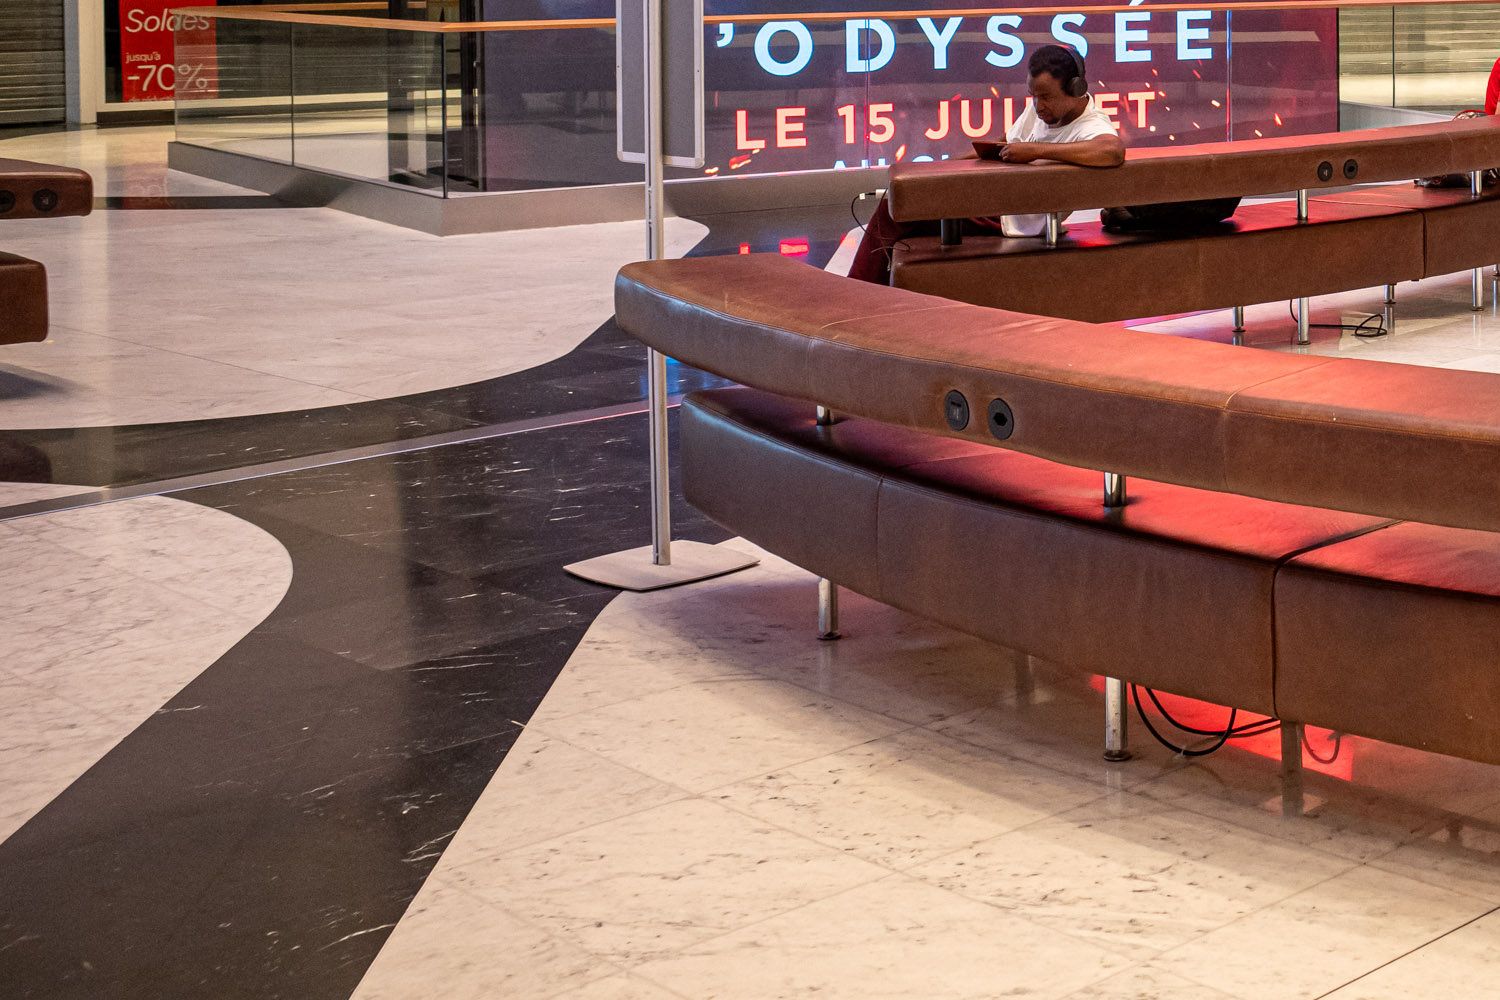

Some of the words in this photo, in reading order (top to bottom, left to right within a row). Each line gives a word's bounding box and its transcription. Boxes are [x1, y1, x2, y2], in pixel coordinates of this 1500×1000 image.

[125, 7, 211, 33] Soldes
[125, 51, 161, 64] jusqu'à
[127, 63, 208, 92] -70%
[736, 106, 807, 150] LE
[837, 103, 896, 144] 15
[924, 90, 1155, 139] JUIET
